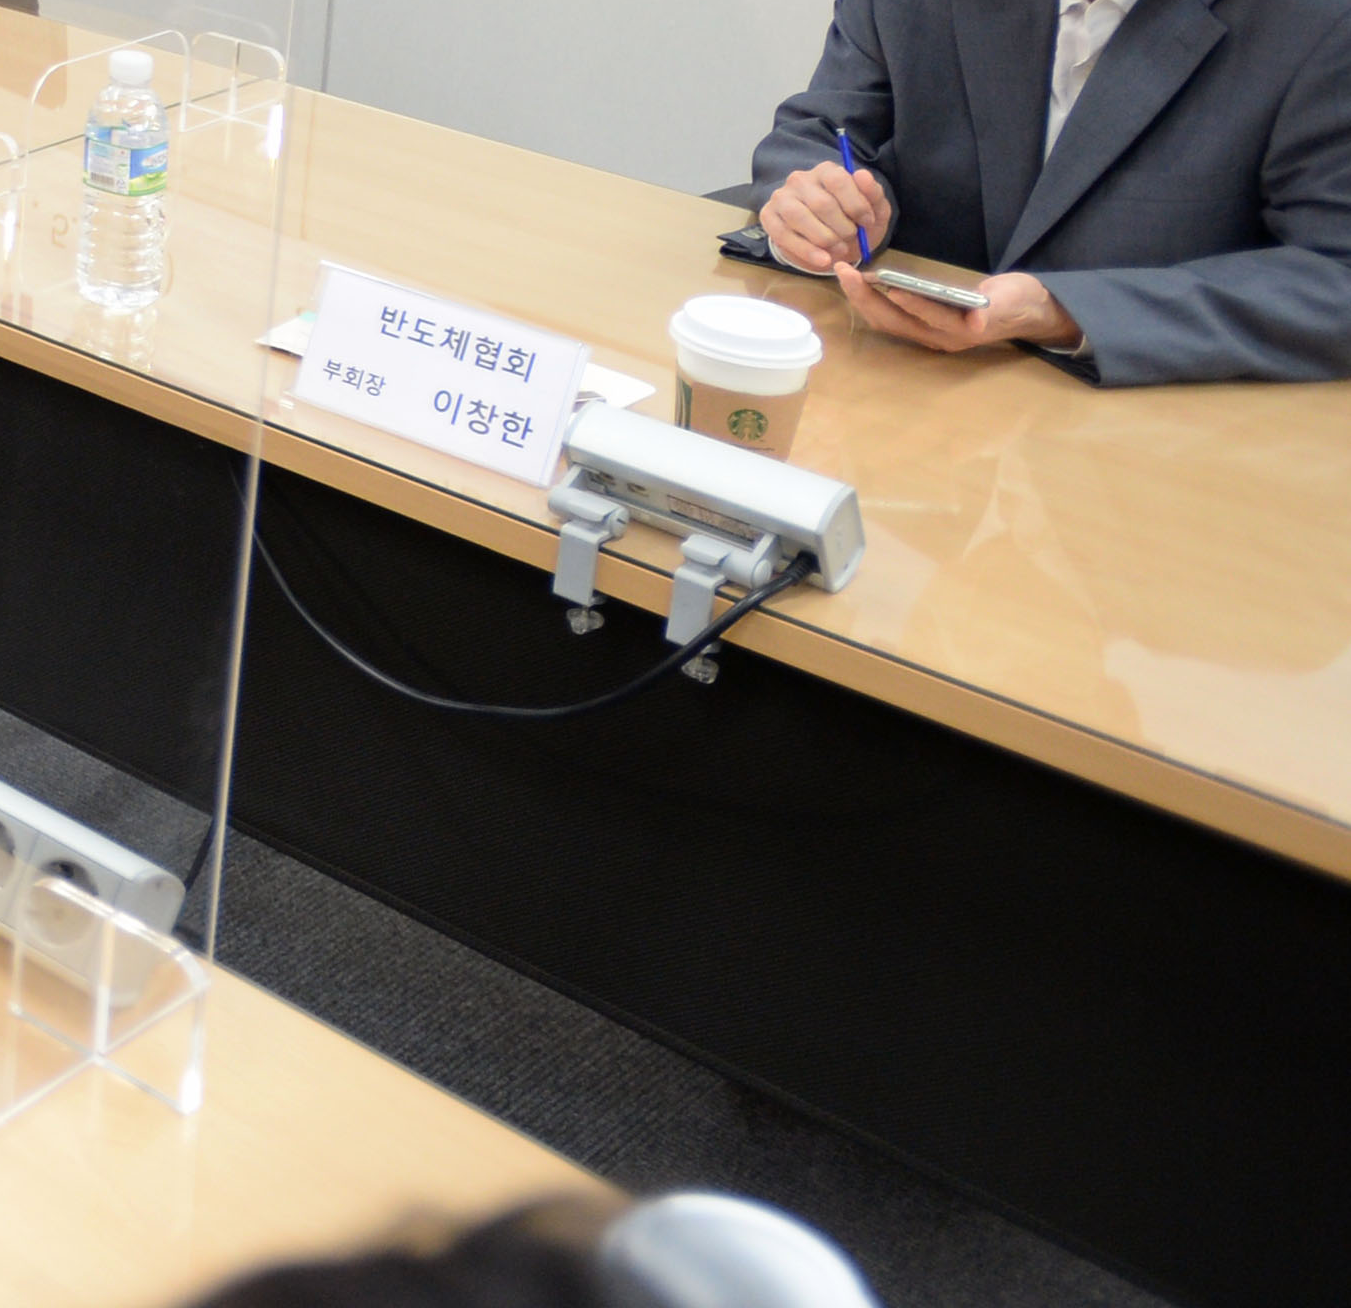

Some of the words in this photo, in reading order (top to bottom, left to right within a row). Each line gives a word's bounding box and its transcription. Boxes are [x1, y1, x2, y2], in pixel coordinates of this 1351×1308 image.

[379, 305, 536, 383] 반도체협회
[323, 359, 386, 397] 부회장
[433, 389, 534, 449] 이창한
